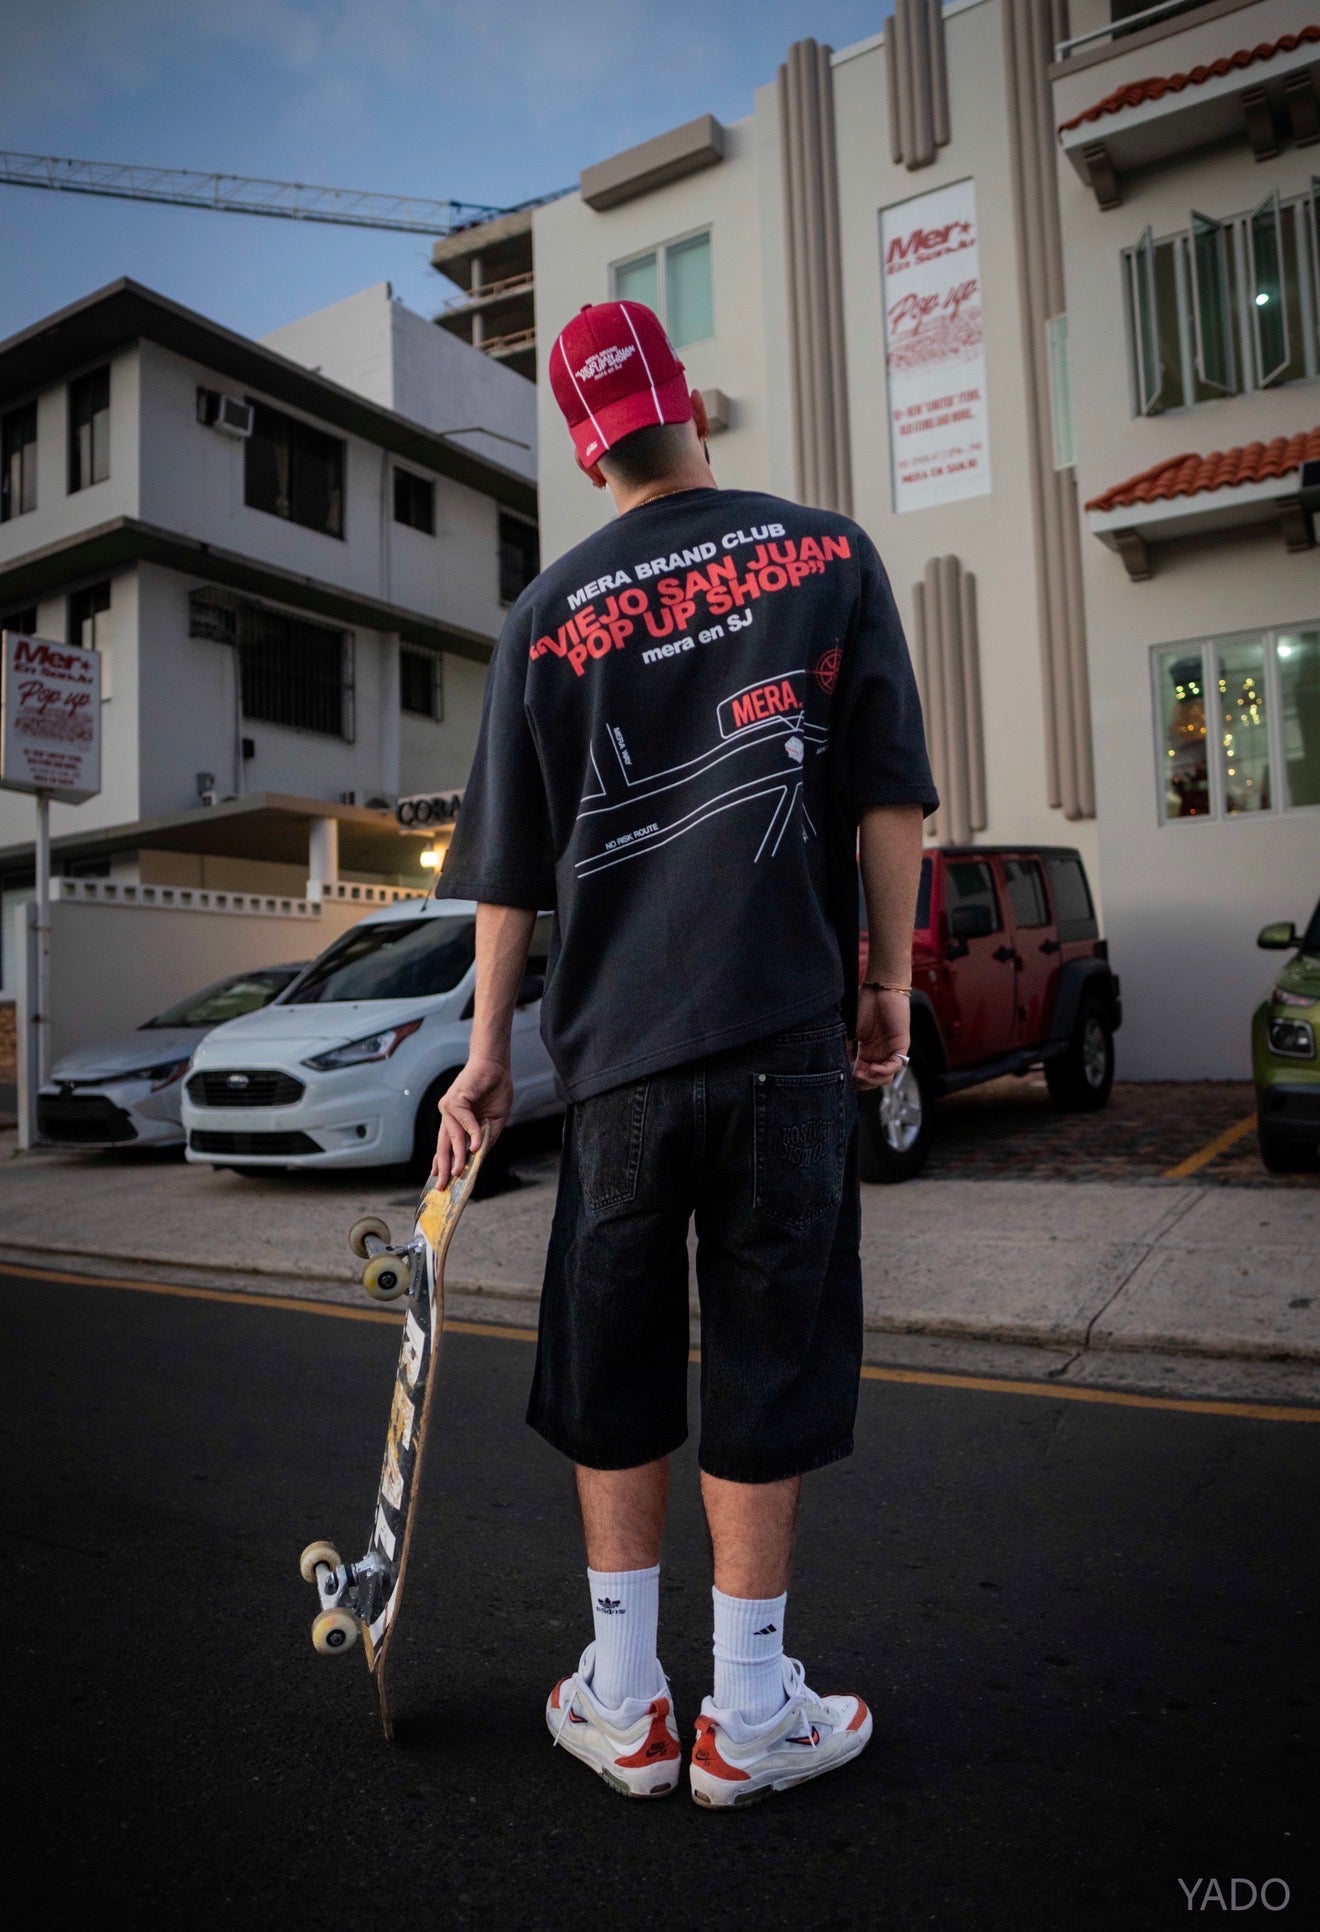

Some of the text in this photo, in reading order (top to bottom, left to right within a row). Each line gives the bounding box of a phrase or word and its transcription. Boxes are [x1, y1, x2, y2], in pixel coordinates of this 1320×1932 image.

[566, 523, 786, 611] MERA BRAND CLUB
[529, 535, 851, 661] “VIEJO SAN JUAN
[566, 618, 635, 677] POP
[643, 600, 697, 638] UP
[641, 608, 754, 665] mera en SJ
[18, 680, 61, 715] Pop
[613, 727, 632, 765] MERA WAY
[605, 822, 659, 851] NO RISK ROUTE
